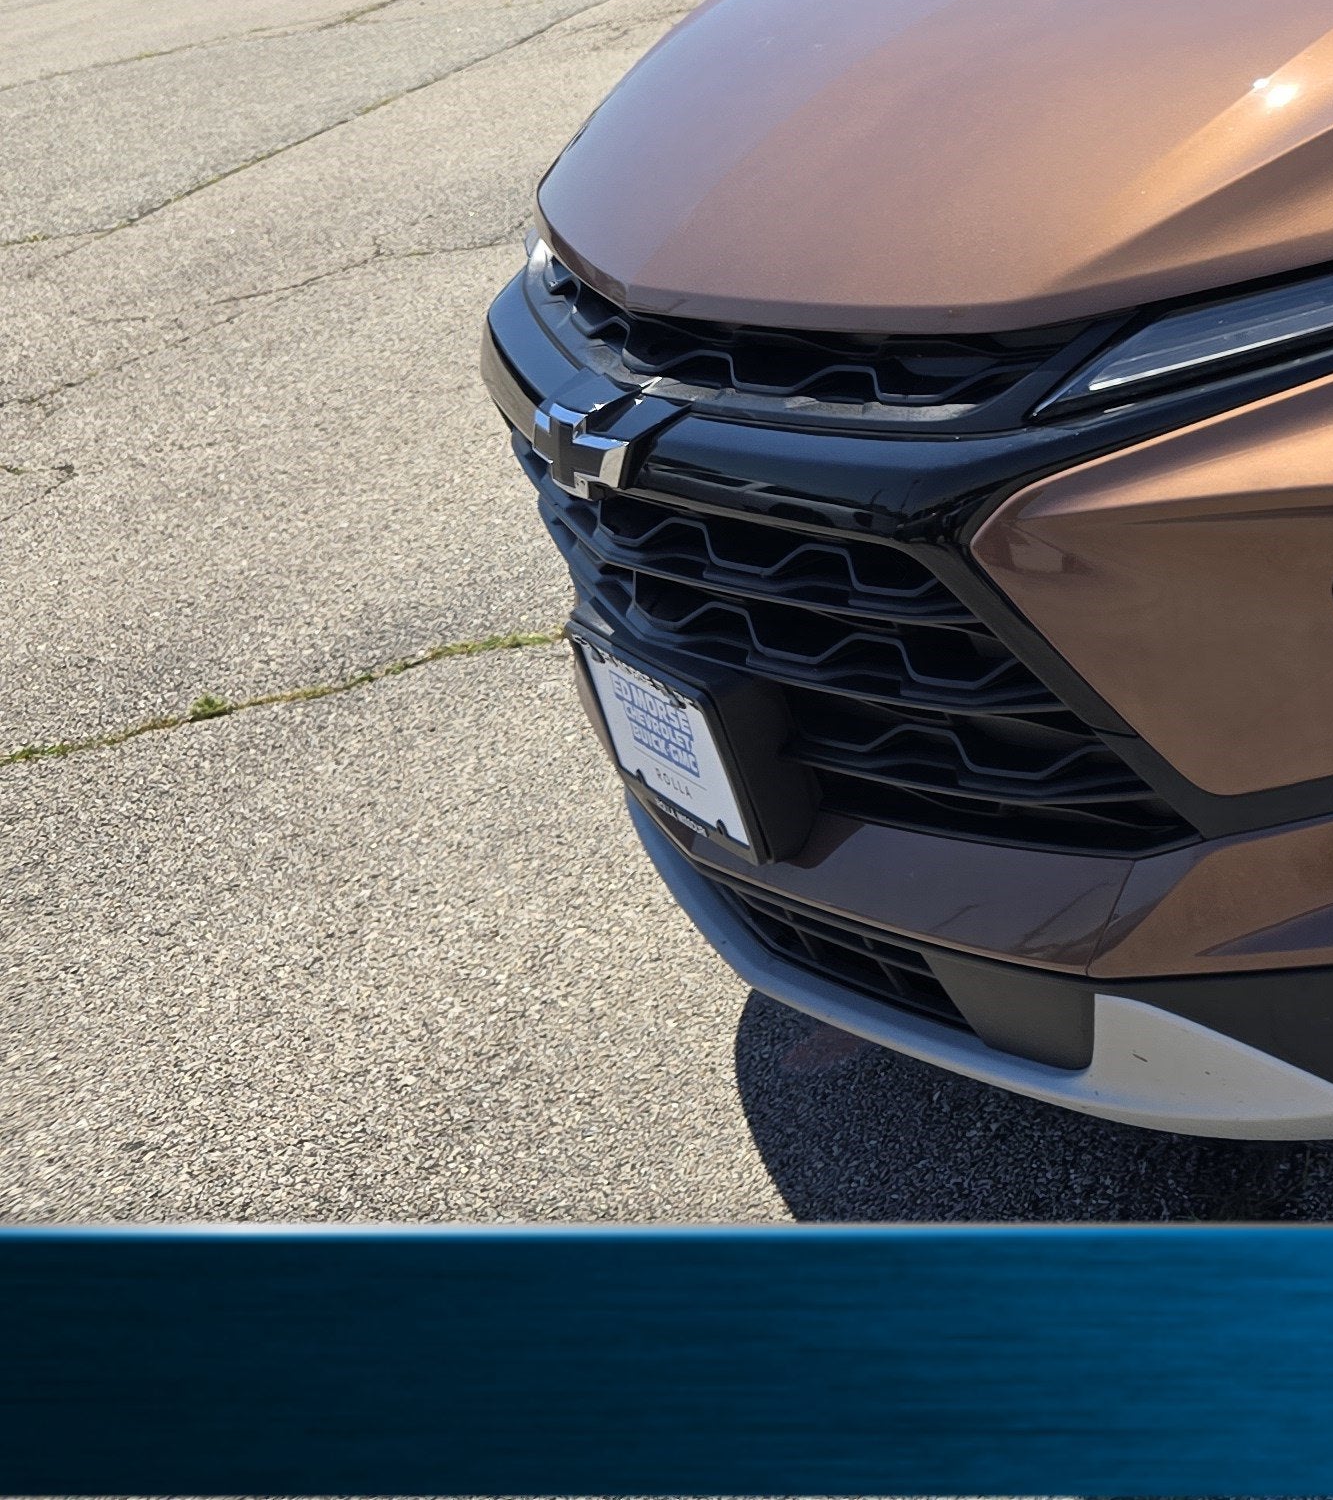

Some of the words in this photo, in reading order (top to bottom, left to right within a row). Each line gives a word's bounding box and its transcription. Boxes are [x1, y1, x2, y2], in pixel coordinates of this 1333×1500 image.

[611, 673, 631, 701] ED
[629, 682, 692, 737] MORSE
[655, 767, 693, 799] ROLLA
